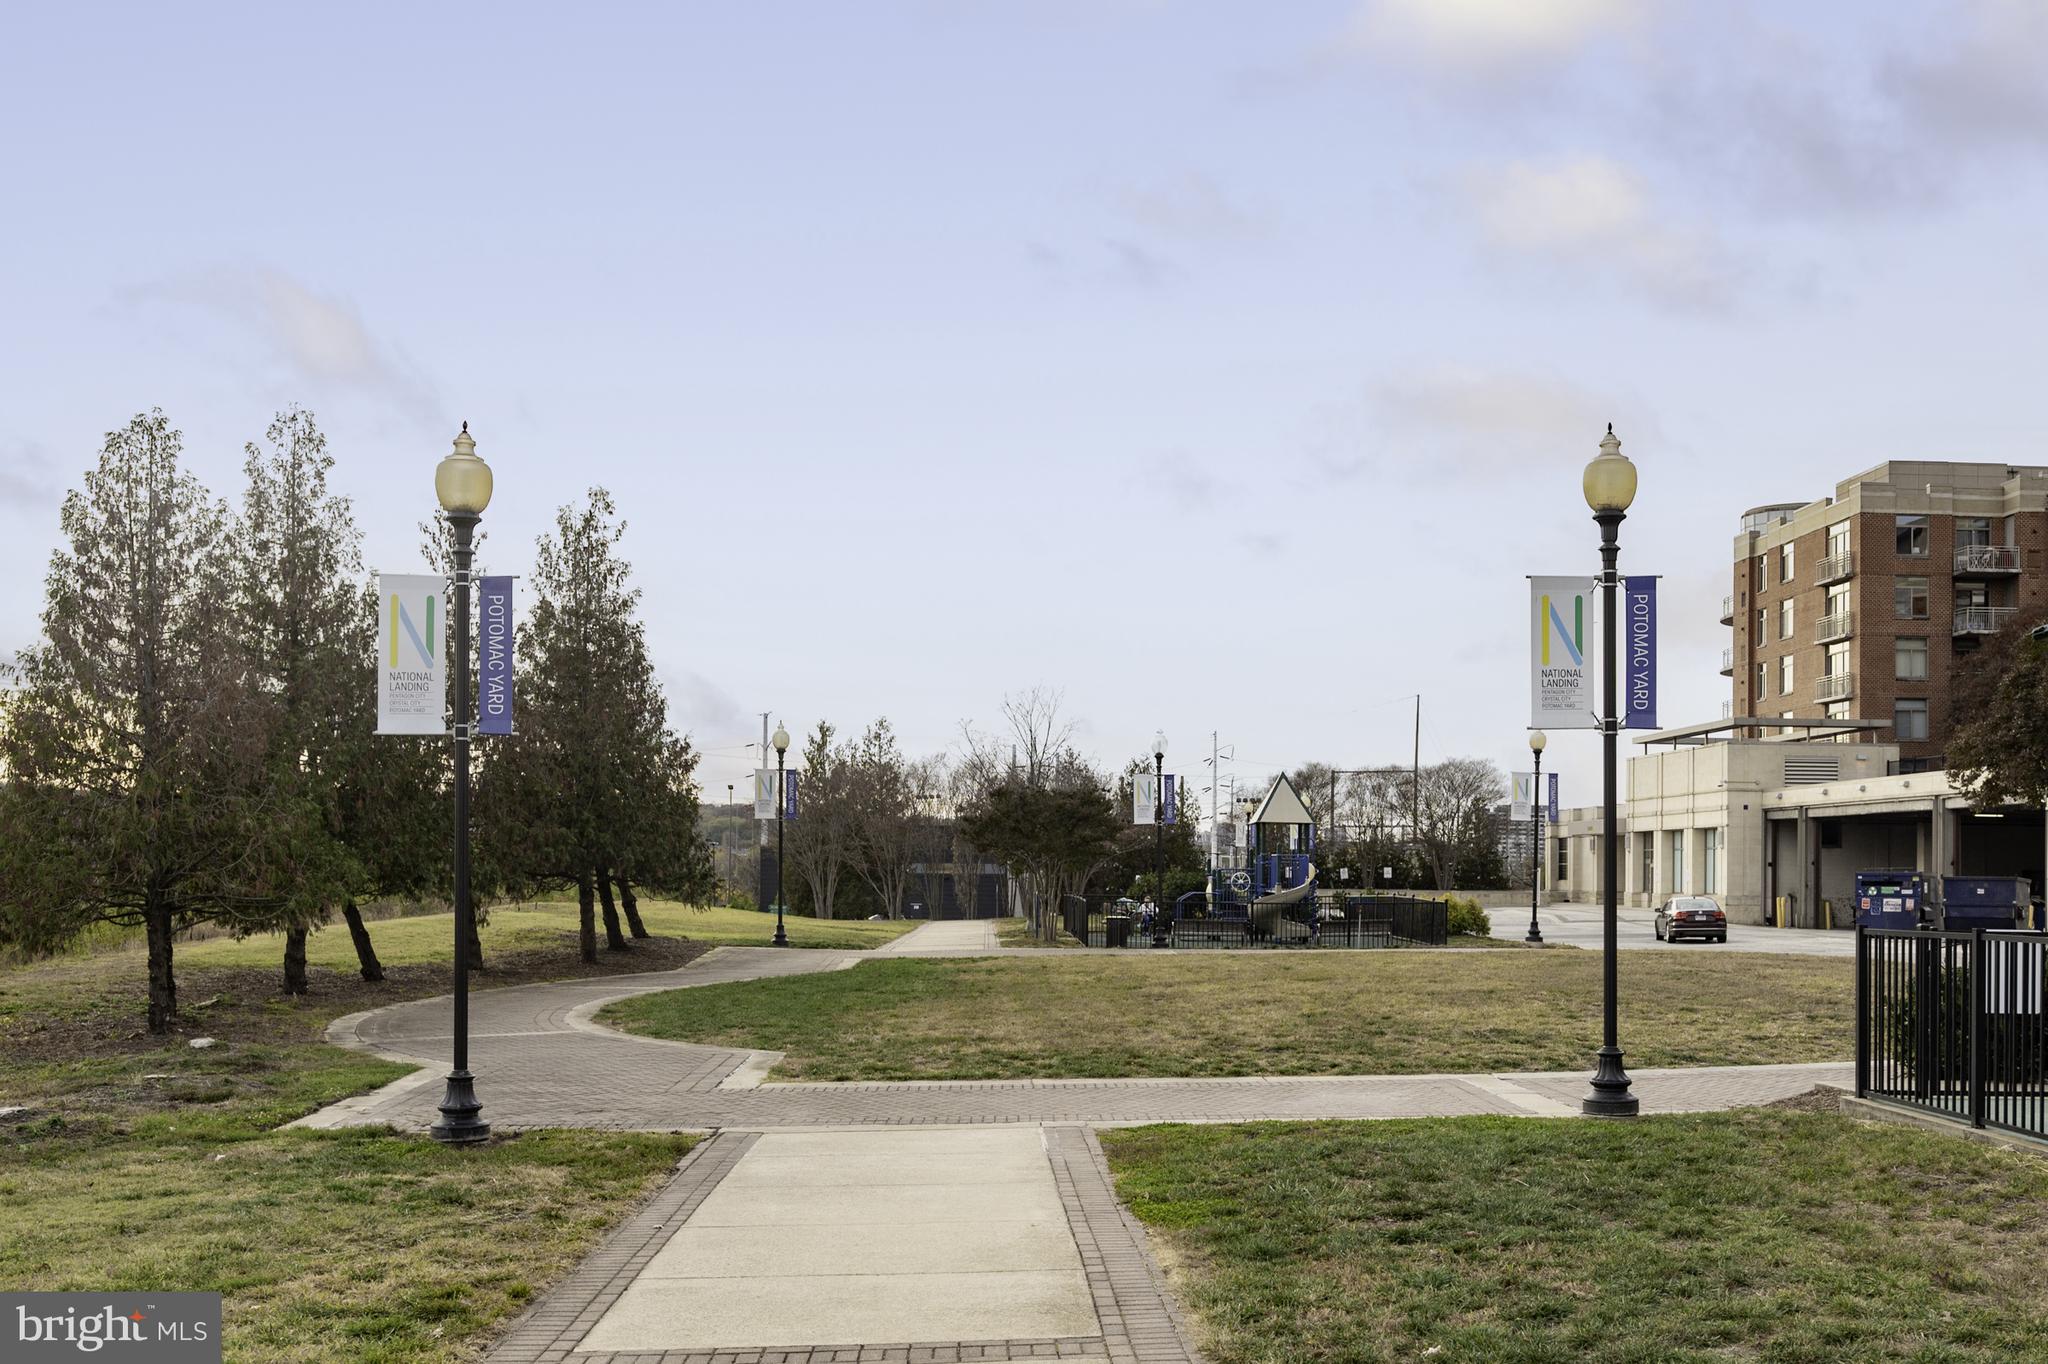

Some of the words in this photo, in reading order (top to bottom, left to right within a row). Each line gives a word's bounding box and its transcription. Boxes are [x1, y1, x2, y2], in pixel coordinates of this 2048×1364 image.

[389, 593, 435, 669] N
[488, 595, 505, 670] POTOMAC
[1541, 594, 1583, 666] N
[1633, 594, 1649, 667] POTOMAC
[389, 671, 434, 681] NATIONAL
[389, 681, 429, 691] LANDING
[1541, 669, 1583, 678] NATIONAL
[1541, 678, 1579, 688] LANDING
[1633, 671, 1649, 710] YARD
[488, 674, 504, 715] YARD
